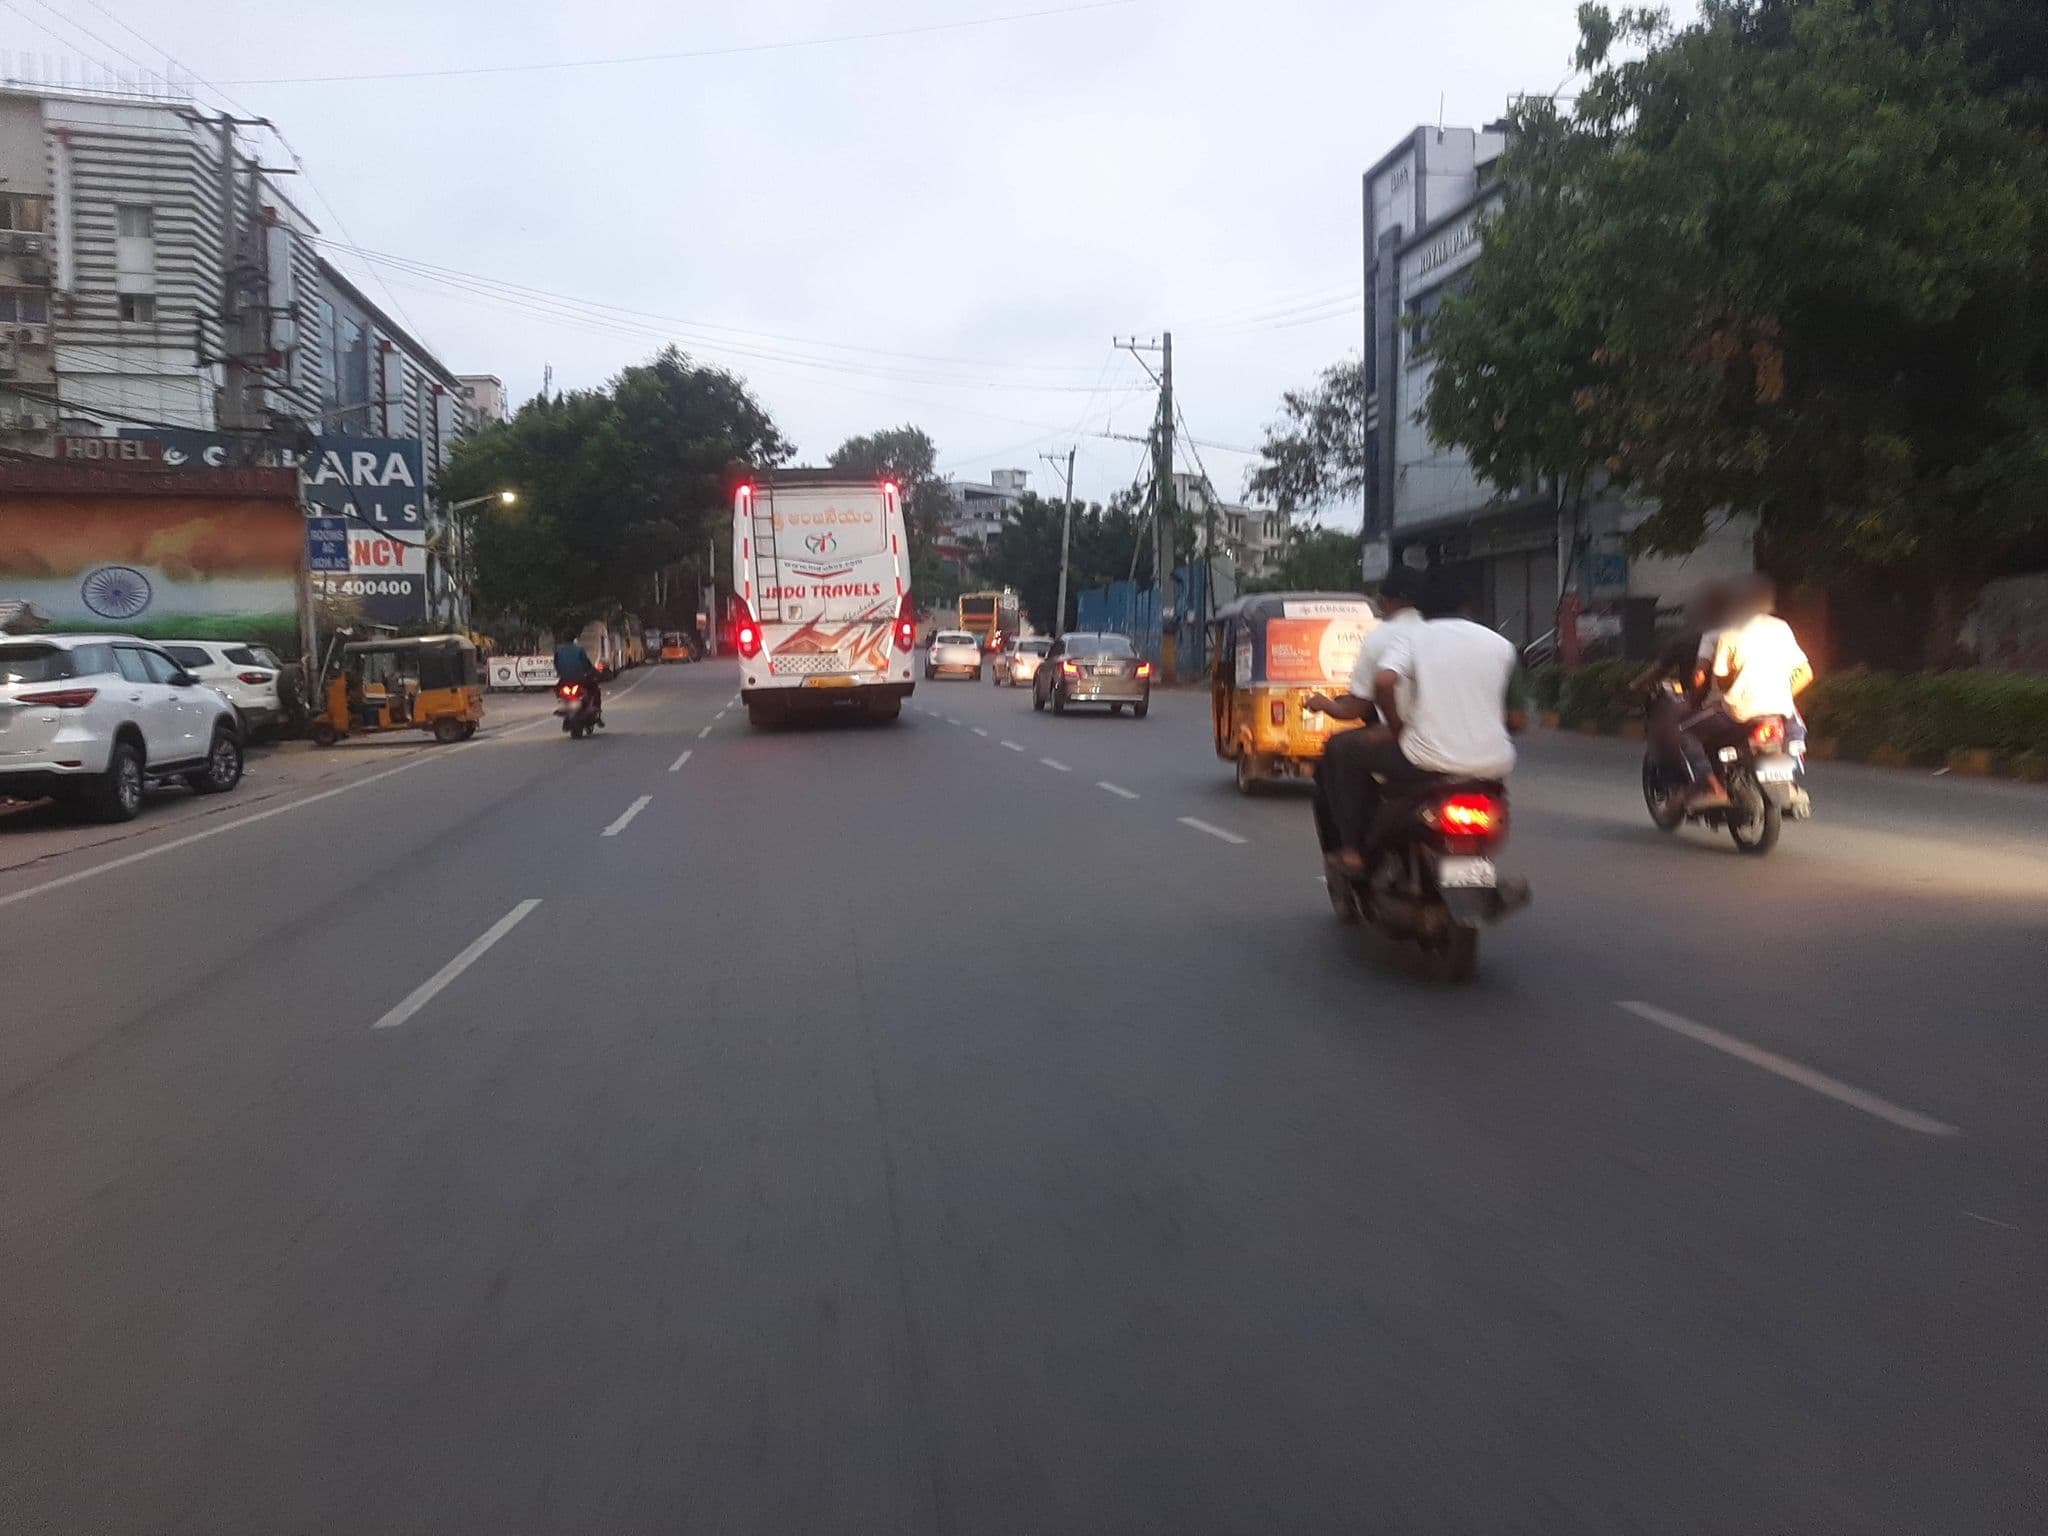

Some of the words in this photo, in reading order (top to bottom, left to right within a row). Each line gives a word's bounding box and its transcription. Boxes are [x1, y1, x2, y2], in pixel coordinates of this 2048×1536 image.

[65, 438, 152, 460] HOTEL
[766, 586, 806, 599] INDU
[811, 583, 881, 599] TRAVELS
